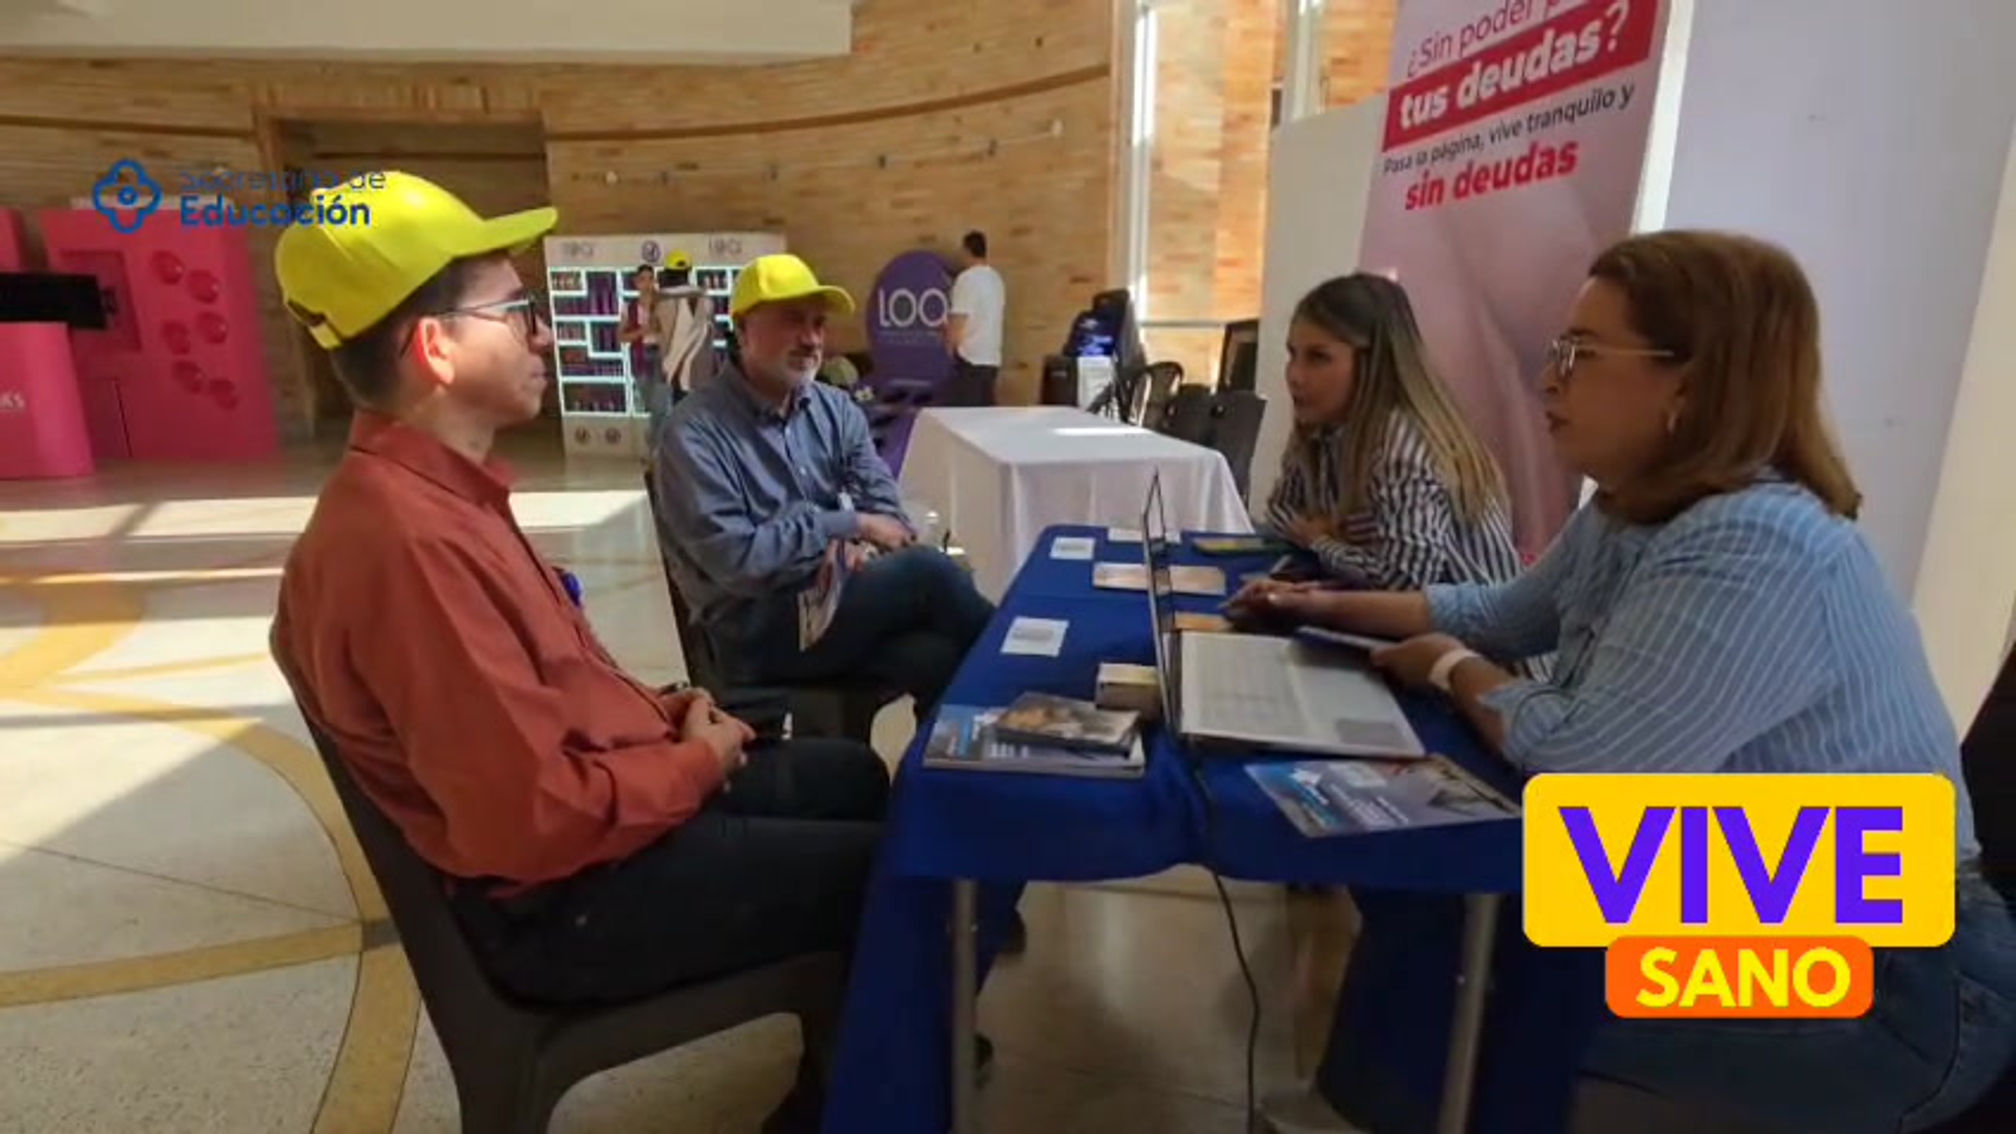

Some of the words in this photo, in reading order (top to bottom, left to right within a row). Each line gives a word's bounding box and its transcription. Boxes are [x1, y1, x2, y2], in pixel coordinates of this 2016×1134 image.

[1400, 85, 1448, 130] tus
[1456, 0, 1630, 109] deudas?
[1407, 32, 1452, 78] ¿Sin
[1489, 118, 1523, 145] vive
[1526, 87, 1616, 134] tranquilo
[1618, 81, 1636, 110] y
[1405, 168, 1444, 210] sin
[1453, 140, 1579, 200] deudas
